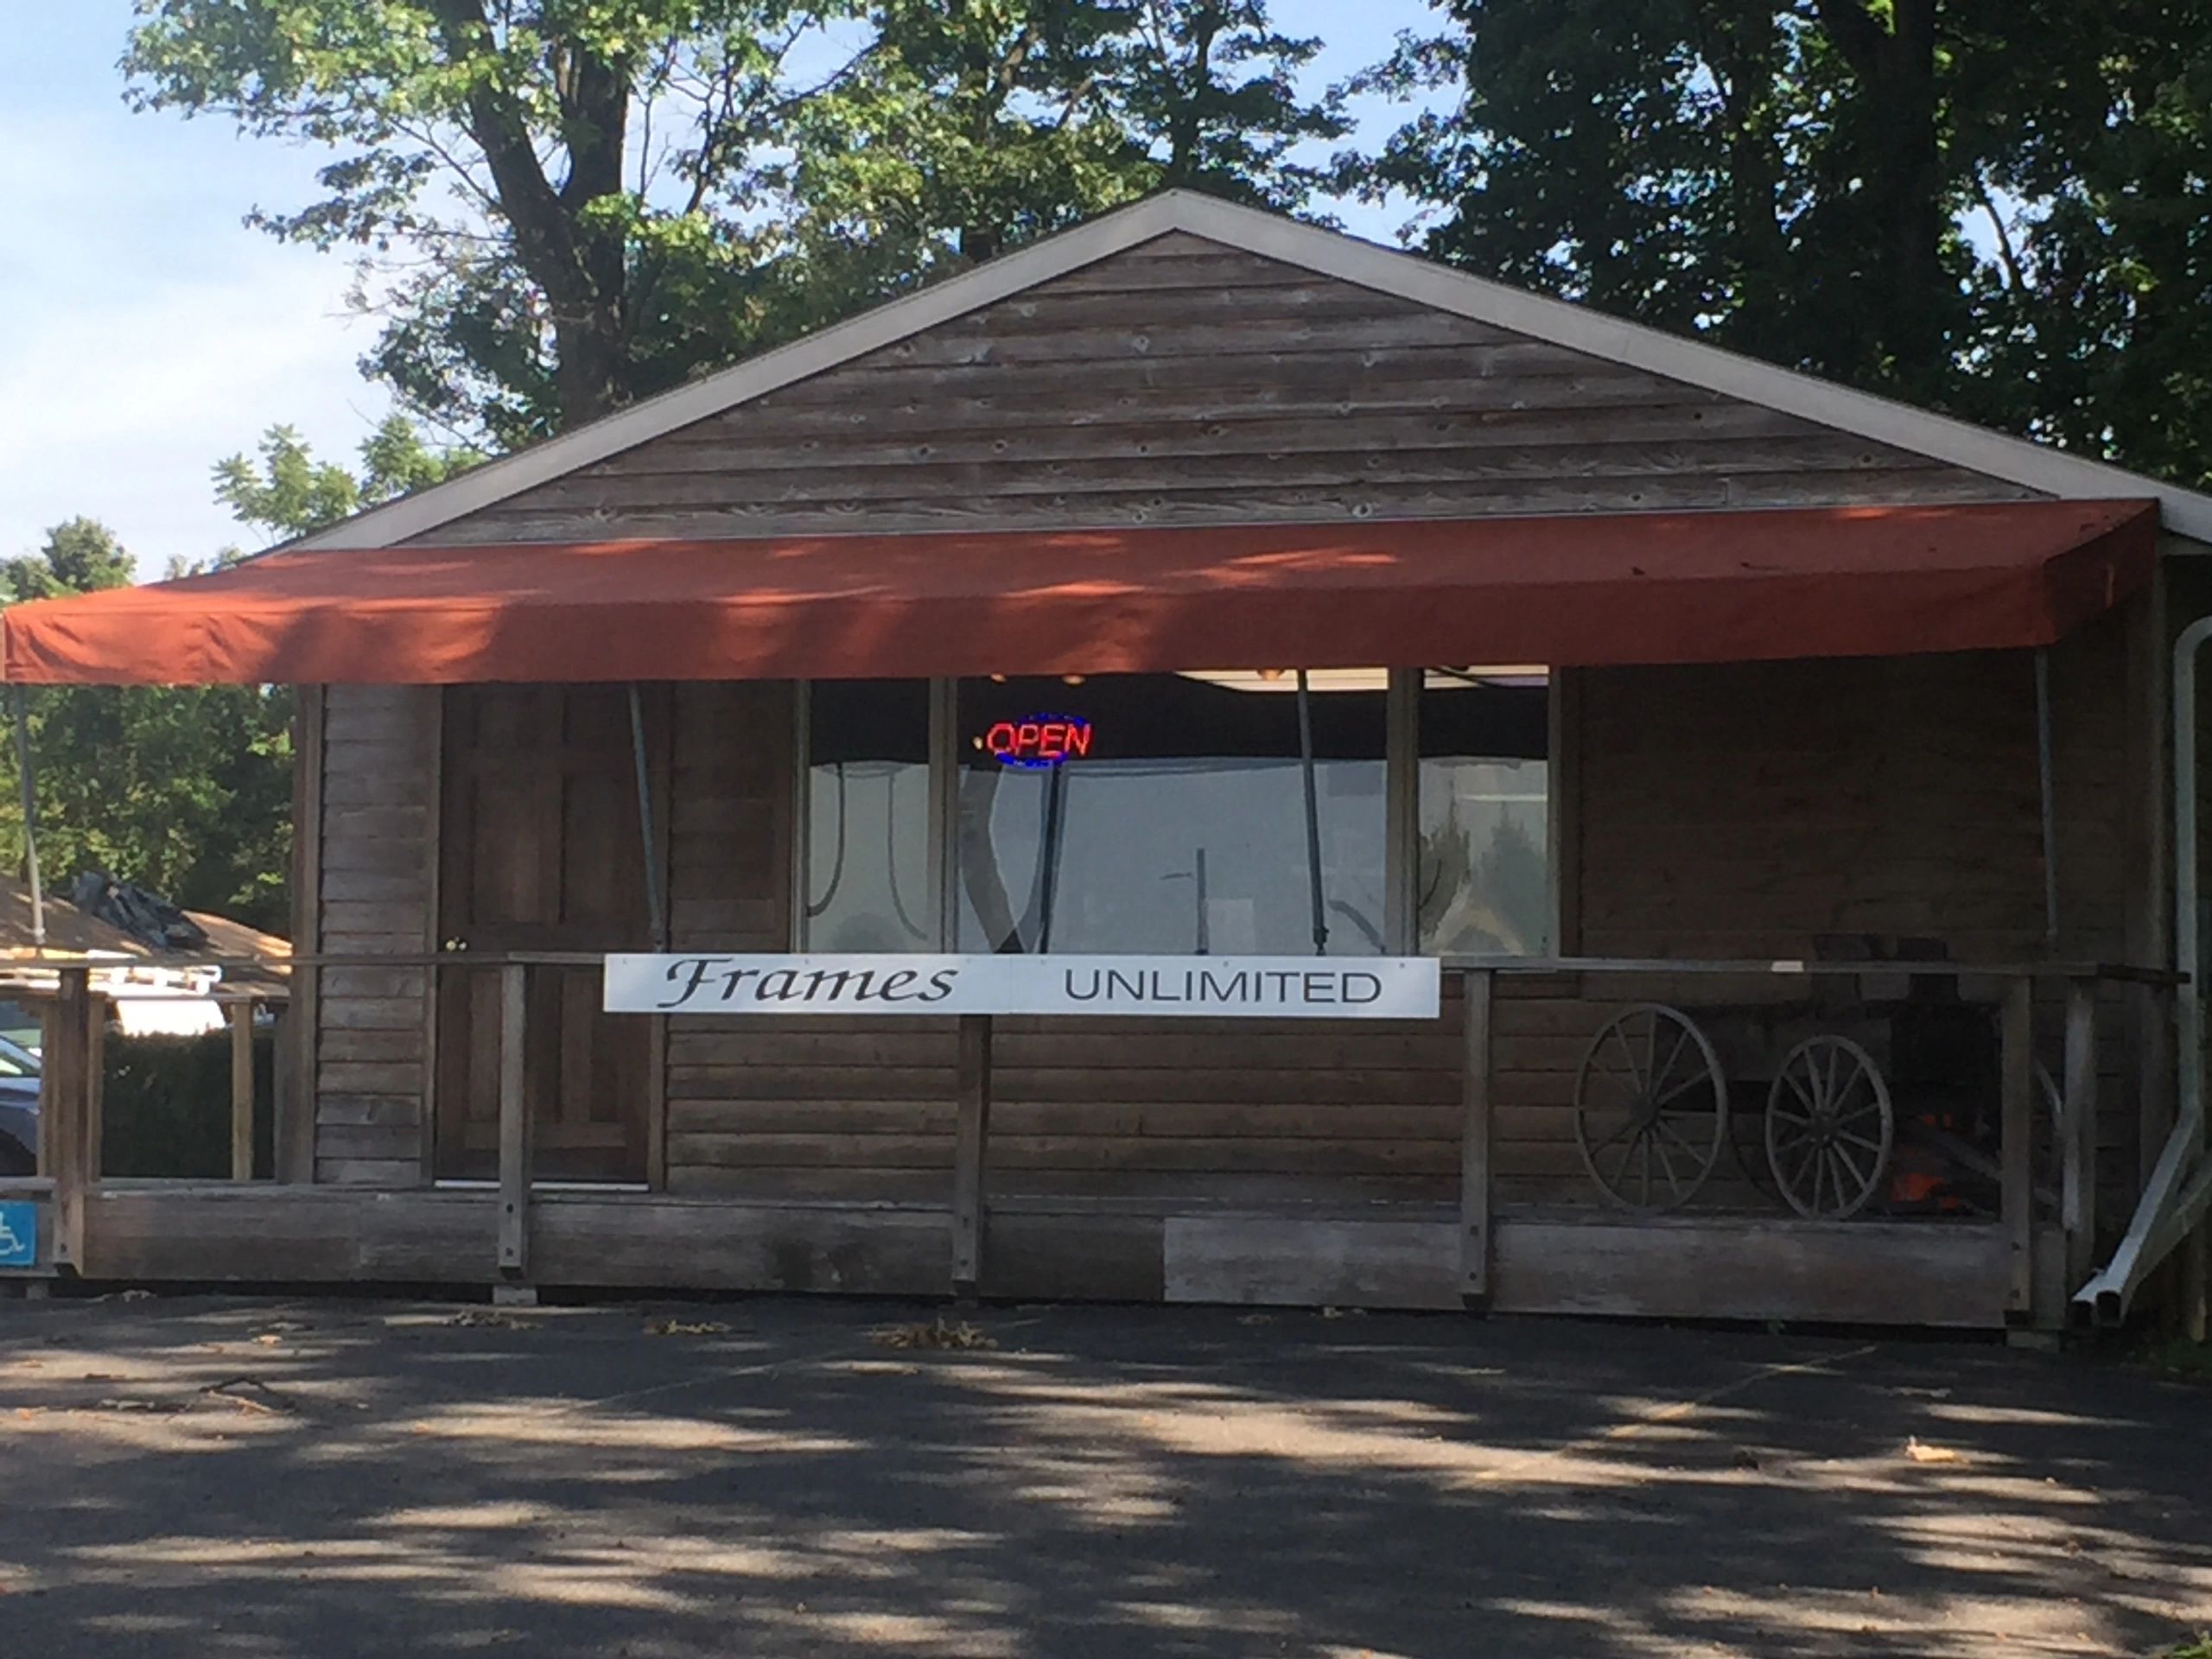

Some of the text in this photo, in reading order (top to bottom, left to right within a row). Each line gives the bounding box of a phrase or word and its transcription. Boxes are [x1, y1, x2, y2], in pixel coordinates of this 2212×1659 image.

[986, 722, 1092, 758] OPEN
[657, 957, 1383, 1009] Frames UNLIMITED
